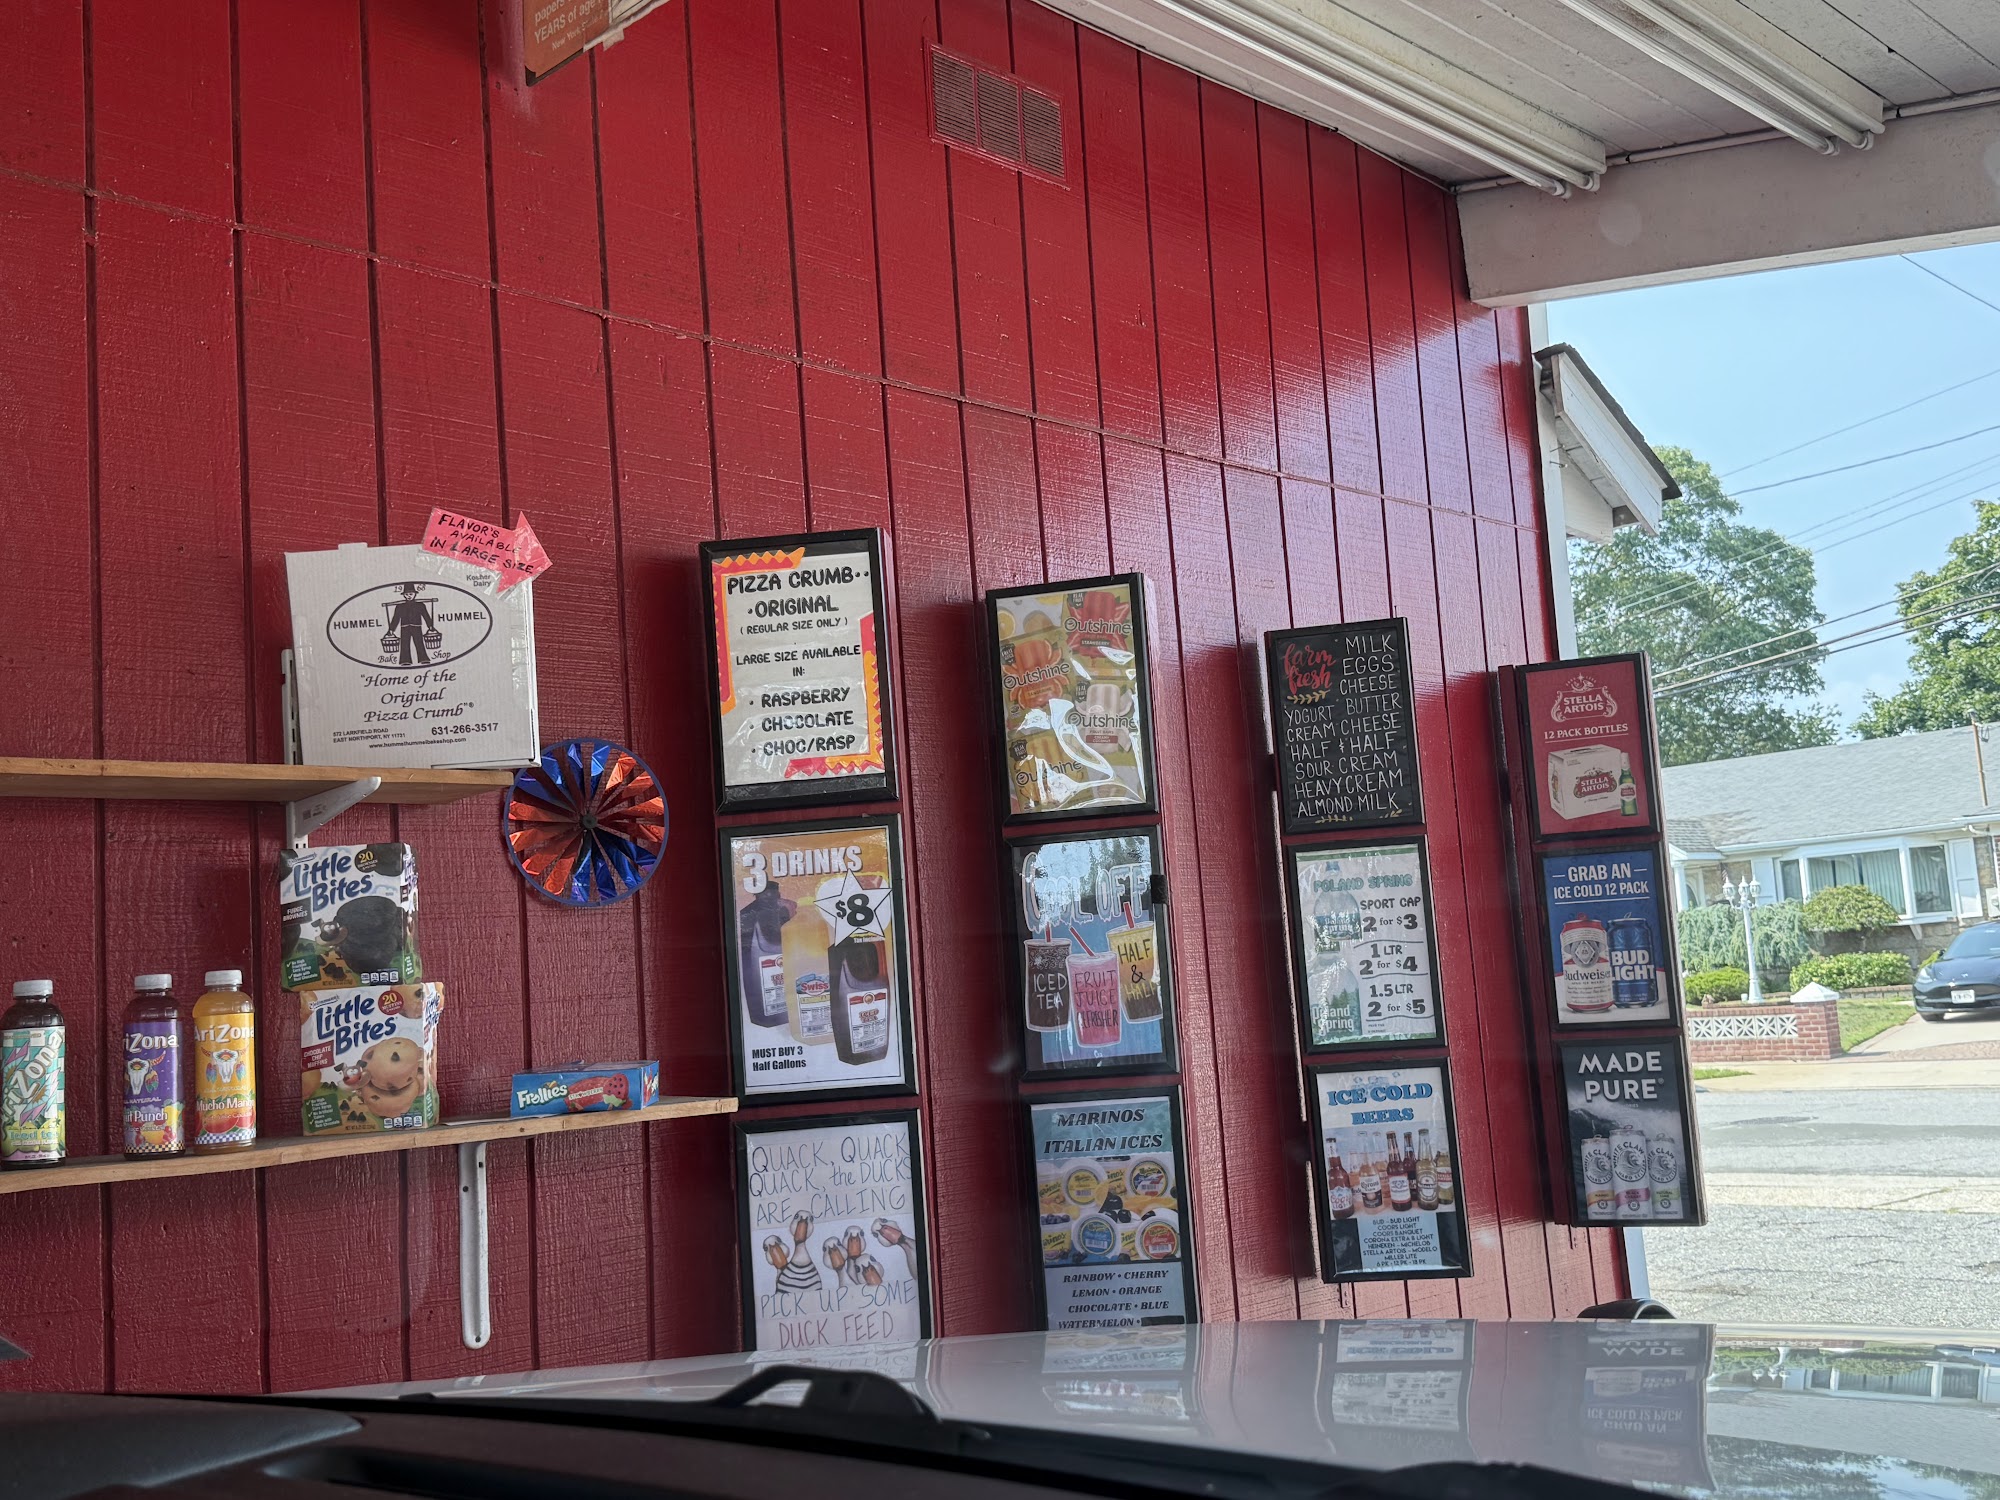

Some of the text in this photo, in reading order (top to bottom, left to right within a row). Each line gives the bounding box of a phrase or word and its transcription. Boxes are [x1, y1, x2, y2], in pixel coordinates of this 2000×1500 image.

[534, 16, 566, 44] YEARS
[568, 6, 578, 23] of
[579, 0, 596, 18] age
[437, 513, 500, 540] FLAVOR'S
[450, 529, 521, 553] AVAILABLE
[429, 535, 534, 575] IN LARGE SIZE
[472, 580, 492, 588] Dairy
[727, 572, 782, 595] PIZZA
[755, 594, 839, 618] ORIGINAL
[333, 619, 383, 630] HUMMEL
[437, 611, 486, 623] HUMMEL
[792, 619, 813, 631] SIZE
[1064, 617, 1132, 635] Outshine
[1345, 634, 1396, 655] MILK
[377, 649, 452, 664] Bake Shop
[736, 645, 861, 665] LARGE SIZE AVAILABLE
[1283, 643, 1337, 676] farm
[1342, 654, 1394, 676] EGGS
[413, 669, 430, 689] of
[433, 668, 457, 682] the
[792, 666, 806, 677] IN:
[1003, 662, 1070, 690] Outshine
[1288, 664, 1333, 695] fresh
[1339, 673, 1398, 696] CHEESE
[380, 687, 445, 708] Original
[761, 687, 850, 708] RASPBERRY
[1346, 691, 1403, 715] BUTTER
[1563, 694, 1603, 706] STELLA
[364, 710, 409, 722] Pizza
[1285, 704, 1335, 727] YOGURT
[1563, 702, 1604, 714] ARTOIS
[431, 723, 500, 736] 631-266-3517
[761, 710, 854, 733] CHOCOLATE
[1067, 712, 1137, 730] Outshine
[1286, 711, 1402, 743] CREAM CHEESE
[1544, 723, 1629, 740] 12 PACK BOTTLES
[763, 734, 856, 756] CHOC/RASP
[1290, 730, 1398, 762] HALF HALF
[1295, 750, 1398, 780] SOUR CREAM
[1294, 767, 1404, 800] HEAVY CREAM
[1580, 776, 1609, 787] STELLA
[1581, 782, 1610, 793] ARTOIS
[1297, 791, 1400, 819] ALMOND MILK
[358, 851, 374, 864] 20
[293, 851, 353, 897] Little
[743, 845, 864, 895] 3 DRINKS
[1567, 862, 1632, 883] GRAB AN
[1095, 862, 1151, 923] OFF
[1313, 873, 1414, 893] POLAND SPRING
[1553, 880, 1650, 899] ICE COLD 12 PACK
[312, 874, 373, 913] Bites
[1360, 896, 1421, 911] SPORT CAP
[287, 906, 304, 915] FUDGE
[835, 893, 874, 928] $8
[1362, 916, 1378, 933] 2
[1379, 917, 1395, 926] for
[1396, 913, 1418, 930] $3
[1117, 939, 1152, 964] HALF
[1371, 943, 1403, 959] 1 LTR
[1611, 949, 1650, 965] BUD
[1130, 964, 1145, 984] &
[1359, 956, 1418, 976] 2 for $4
[801, 982, 829, 992] Swiss
[1034, 972, 1067, 993] ICED
[1074, 970, 1118, 989] FRUIT
[382, 993, 398, 1006] 20
[1075, 989, 1116, 1008] JUICE
[1124, 982, 1157, 1001] HALF
[1369, 983, 1414, 998] 1.5 LTR
[1036, 992, 1064, 1010] TEA
[1367, 998, 1426, 1018] 2 for $5
[315, 994, 376, 1040] Little
[1076, 1009, 1119, 1029] REFRESHER
[336, 1016, 399, 1056] Bites
[303, 1046, 331, 1058] CHOCOLATE
[311, 1054, 324, 1062] CHIP
[751, 1046, 804, 1060] MUST BUY 3
[1577, 1050, 1663, 1074] MADE
[307, 1059, 328, 1068] MUFFINS
[752, 1059, 807, 1072] Half Gallons
[1326, 1083, 1433, 1106] ICE COLD
[133, 1107, 168, 1121] Punch
[196, 1099, 225, 1111] Mucho
[1057, 1108, 1145, 1127] MARINOS
[1350, 1107, 1415, 1125] BEERS
[752, 1133, 912, 1173] QUACK, QUACK
[1043, 1133, 1163, 1154] ITALIAN ICES
[1612, 1140, 1645, 1169] WHITE CLAW
[749, 1157, 914, 1197] QUACK, the DUCKS
[757, 1186, 906, 1227] ARE CALLING
[1062, 1270, 1169, 1283] RAINBOW CHERRY
[760, 1279, 917, 1319] PICK UP SOME
[1072, 1285, 1162, 1298] LEMON ORANGE
[1068, 1300, 1169, 1314] CHOCOLATE BLUE
[1058, 1317, 1134, 1329] WATERMELON
[779, 1318, 830, 1350] DUCK
